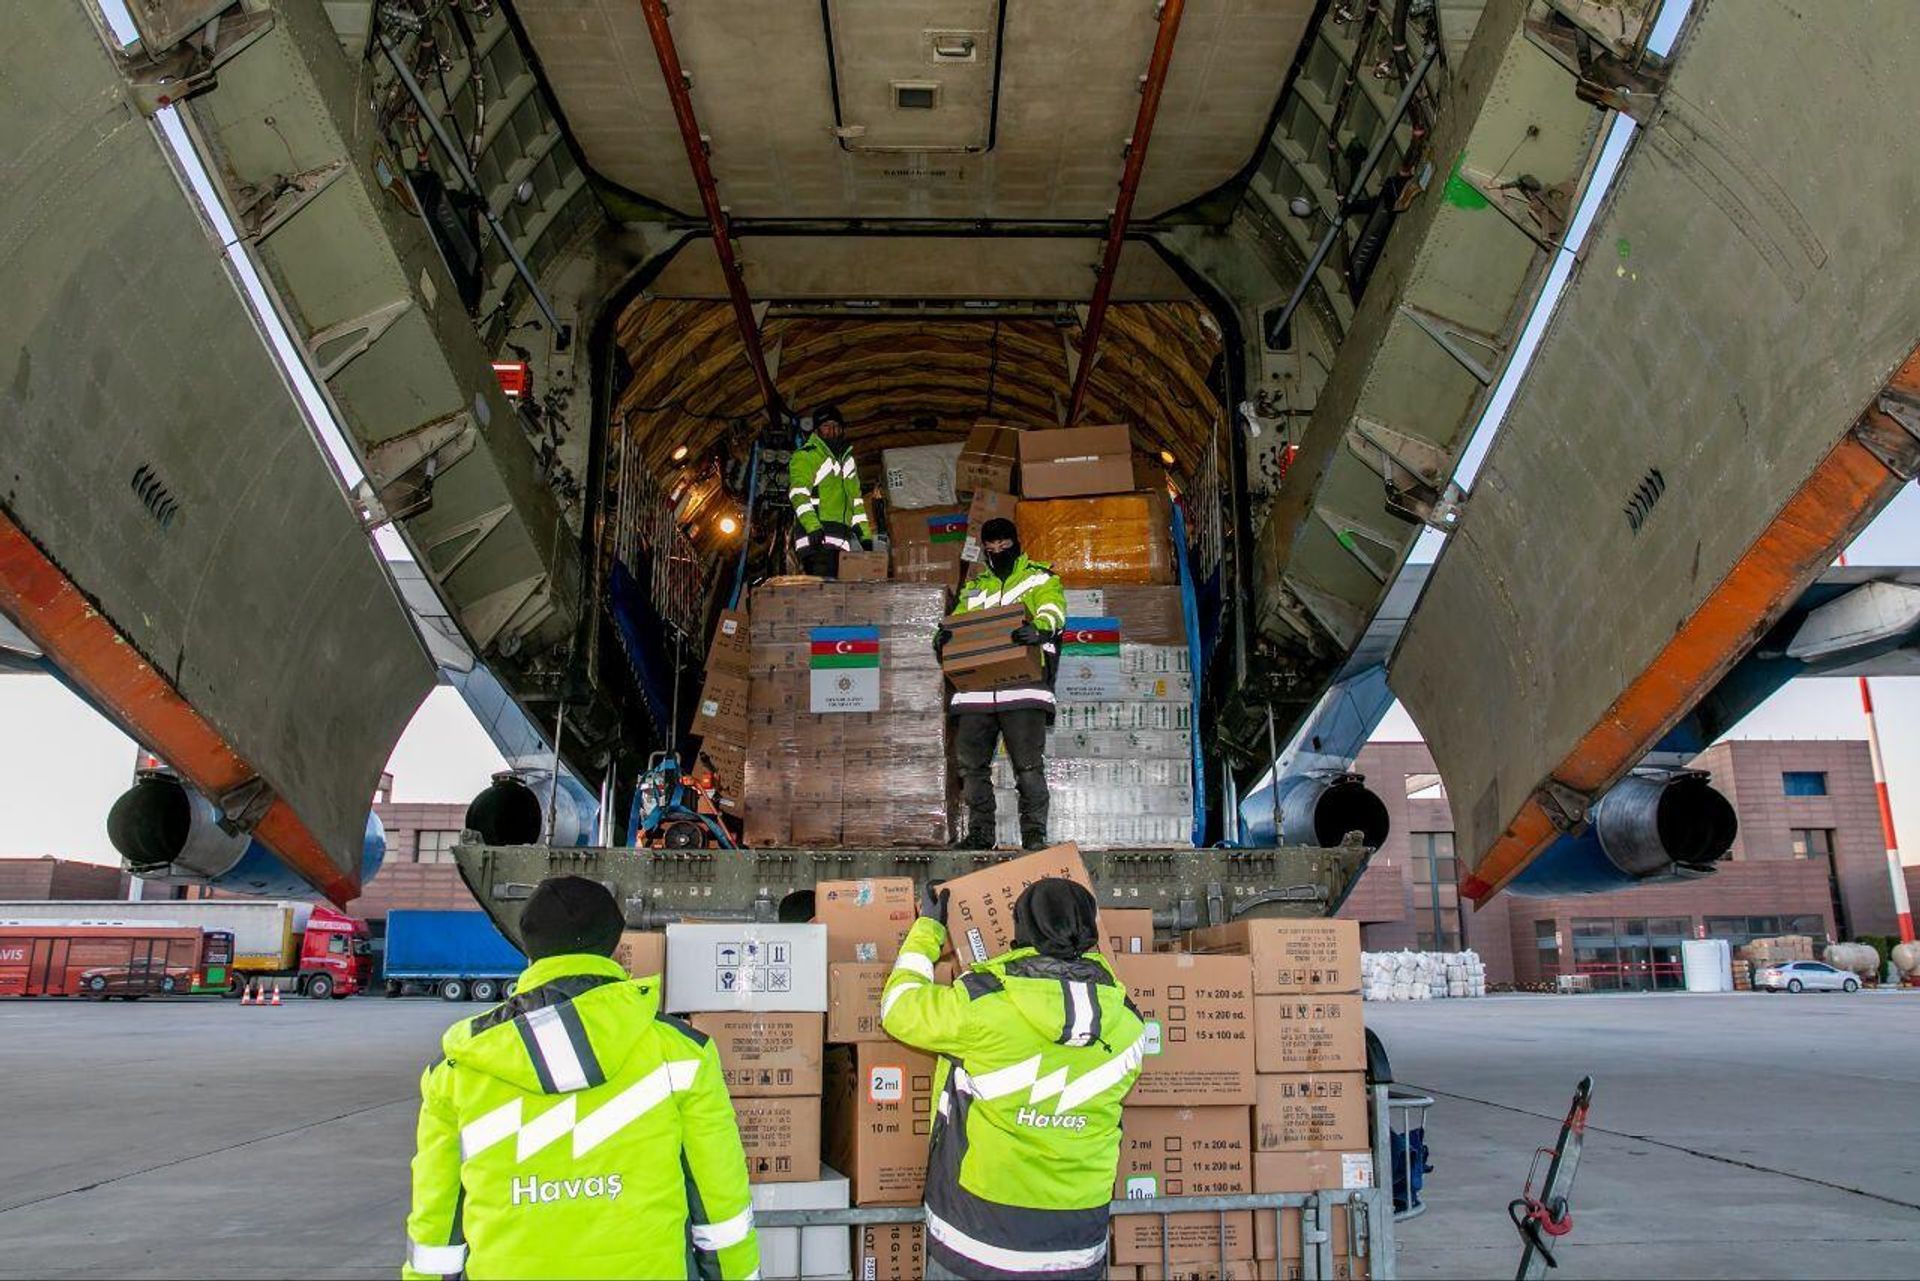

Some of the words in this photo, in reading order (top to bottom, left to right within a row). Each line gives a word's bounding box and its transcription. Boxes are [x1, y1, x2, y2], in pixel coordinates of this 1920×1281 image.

[958, 900, 973, 922] LOT
[982, 893, 993, 906] 18
[988, 907, 998, 918] G
[1134, 988, 1140, 997] 2
[1143, 988, 1155, 997] ml
[874, 1077, 883, 1090] 2
[884, 1080, 899, 1090] ml
[886, 1102, 898, 1111] ml
[1016, 1106, 1088, 1132] Havaş
[871, 1124, 884, 1133] 10
[886, 1123, 900, 1133] ml
[1131, 1140, 1138, 1149] 2
[1140, 1140, 1152, 1149] ml
[1131, 1161, 1138, 1171] 5
[1140, 1161, 1152, 1170] ml
[511, 1173, 623, 1206] Havaş
[865, 1227, 875, 1250] LOT
[891, 1227, 900, 1239] 18
[912, 1227, 921, 1239] 21
[891, 1243, 900, 1252] G
[912, 1243, 921, 1252] G
